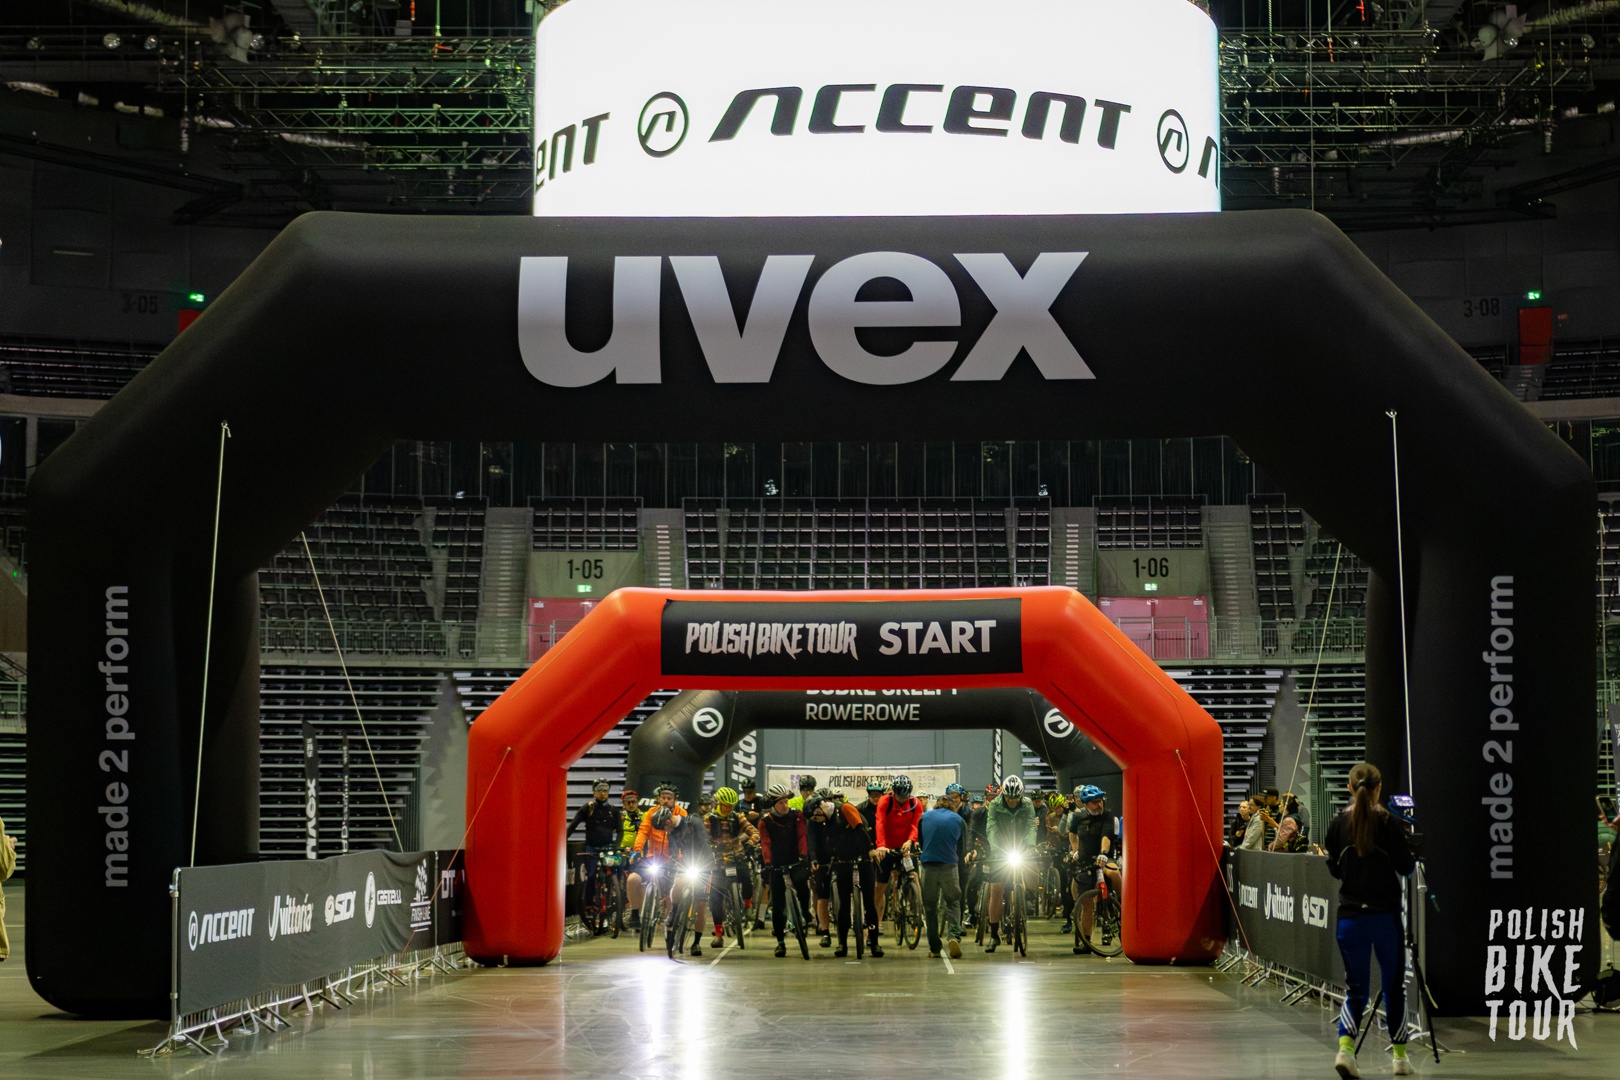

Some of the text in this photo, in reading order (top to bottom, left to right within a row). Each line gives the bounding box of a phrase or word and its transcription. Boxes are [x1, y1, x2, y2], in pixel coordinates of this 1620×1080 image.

[517, 250, 1097, 388] uvex
[1463, 297, 1500, 318] 3-08
[567, 559, 604, 580] 1-05
[1132, 557, 1169, 578] 1-06
[878, 619, 997, 656] START
[805, 702, 921, 721] ROWEROWE
[98, 585, 136, 887] made 2 perform
[1481, 575, 1520, 879] made 2 perform
